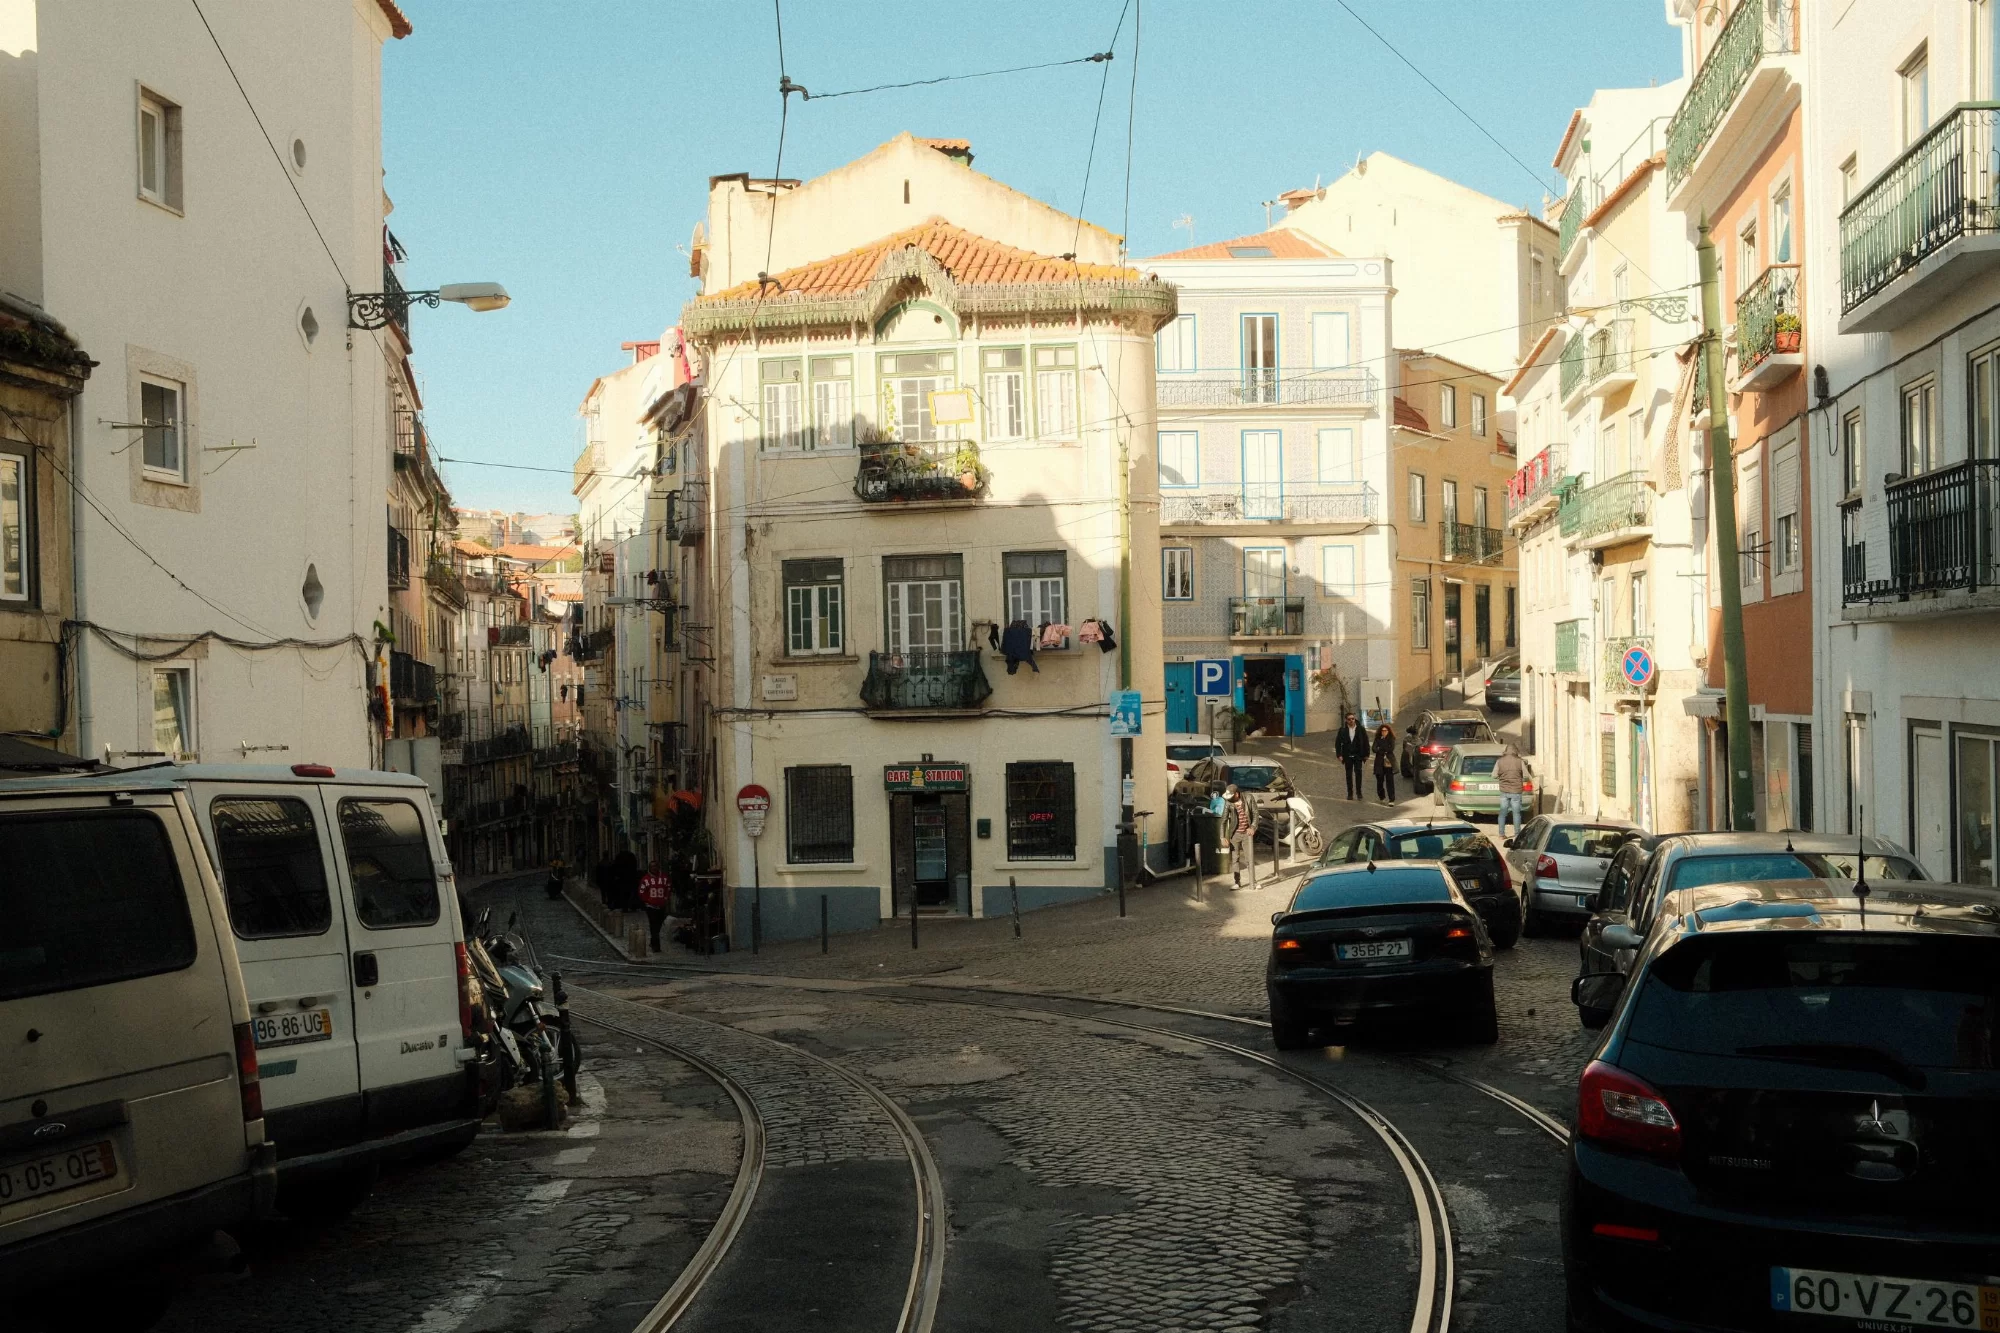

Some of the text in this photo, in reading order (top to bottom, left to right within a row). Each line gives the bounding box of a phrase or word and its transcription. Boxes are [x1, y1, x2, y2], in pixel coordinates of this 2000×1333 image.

[1202, 663, 1222, 692] P
[887, 770, 963, 782] CAFE STATION
[1029, 813, 1053, 821] OPEN
[400, 1040, 434, 1055] Ducato
[1708, 1156, 1772, 1169] MITSUBISHI
[1857, 1321, 1913, 1333] UNIVEX.PT
